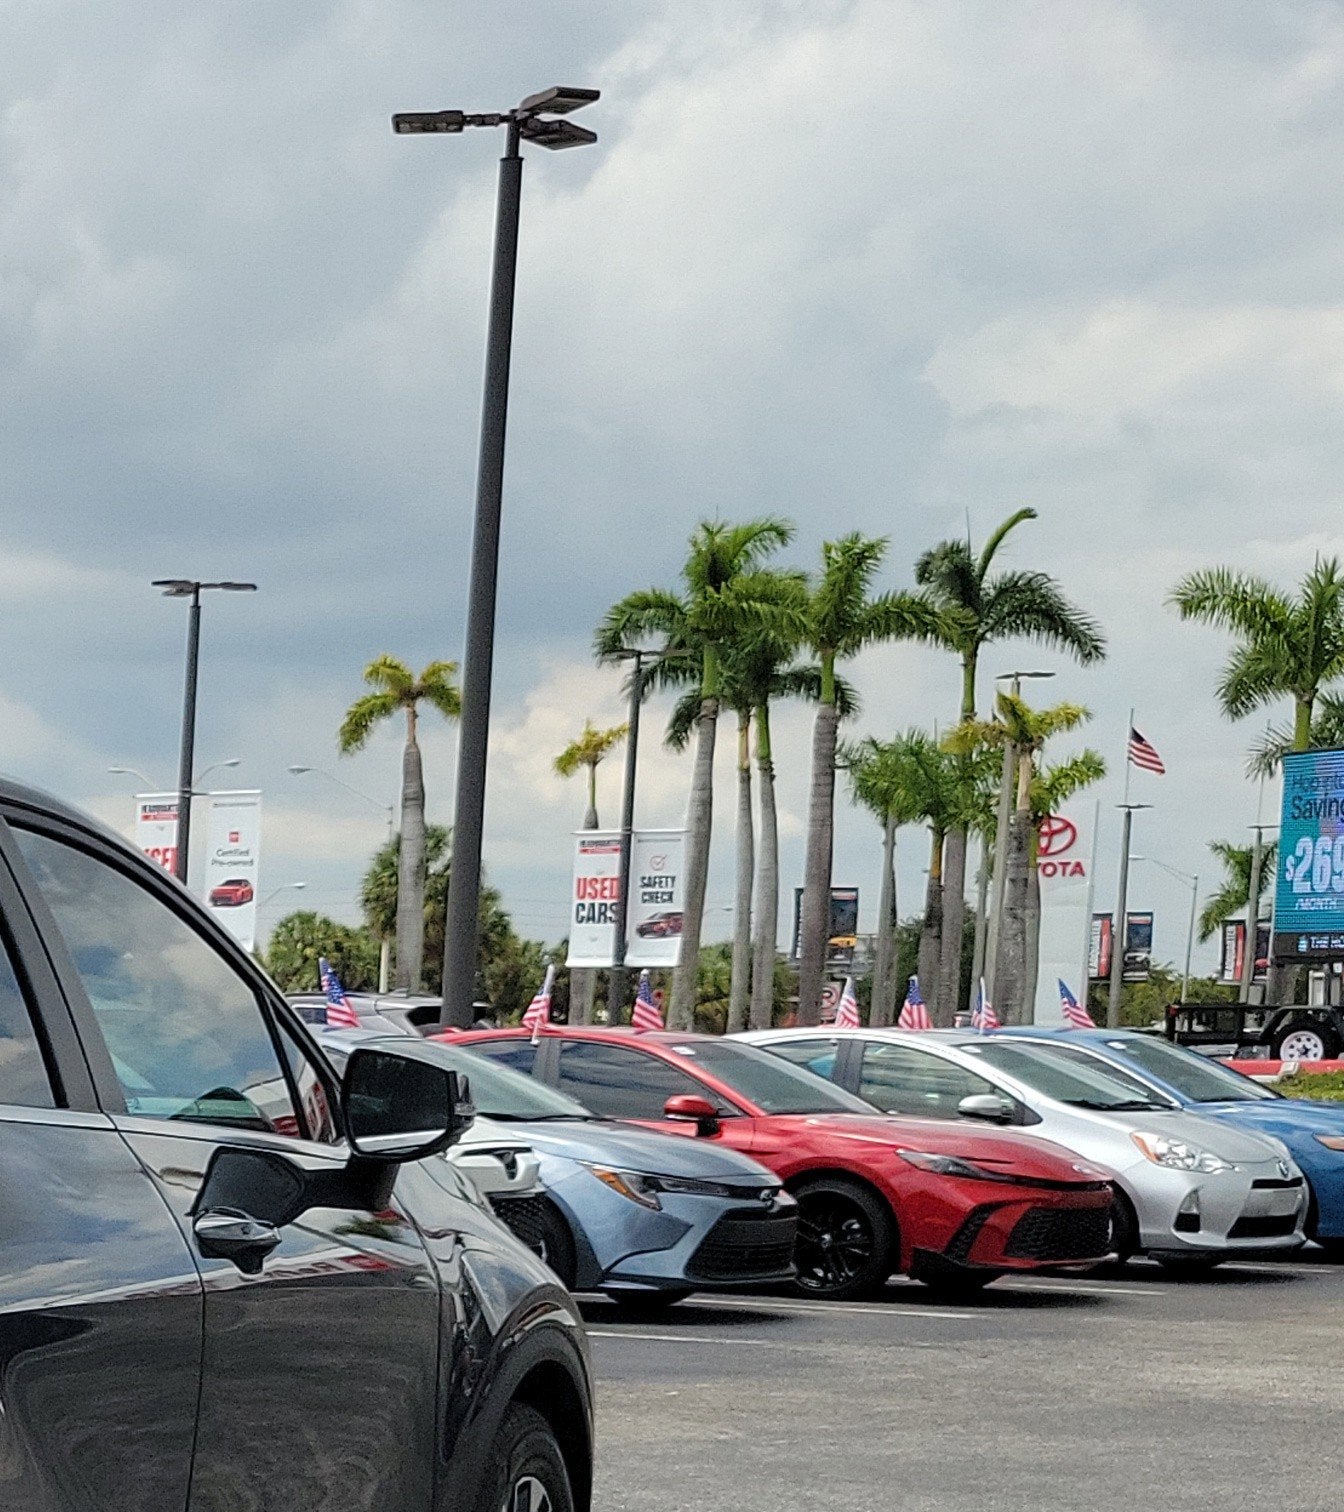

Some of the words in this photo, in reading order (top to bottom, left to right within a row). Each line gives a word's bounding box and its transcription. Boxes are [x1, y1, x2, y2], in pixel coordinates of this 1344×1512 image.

[576, 877, 620, 900] USED
[639, 875, 676, 889] SAFETY
[640, 890, 674, 903] CHECK
[575, 902, 620, 924] CARS
